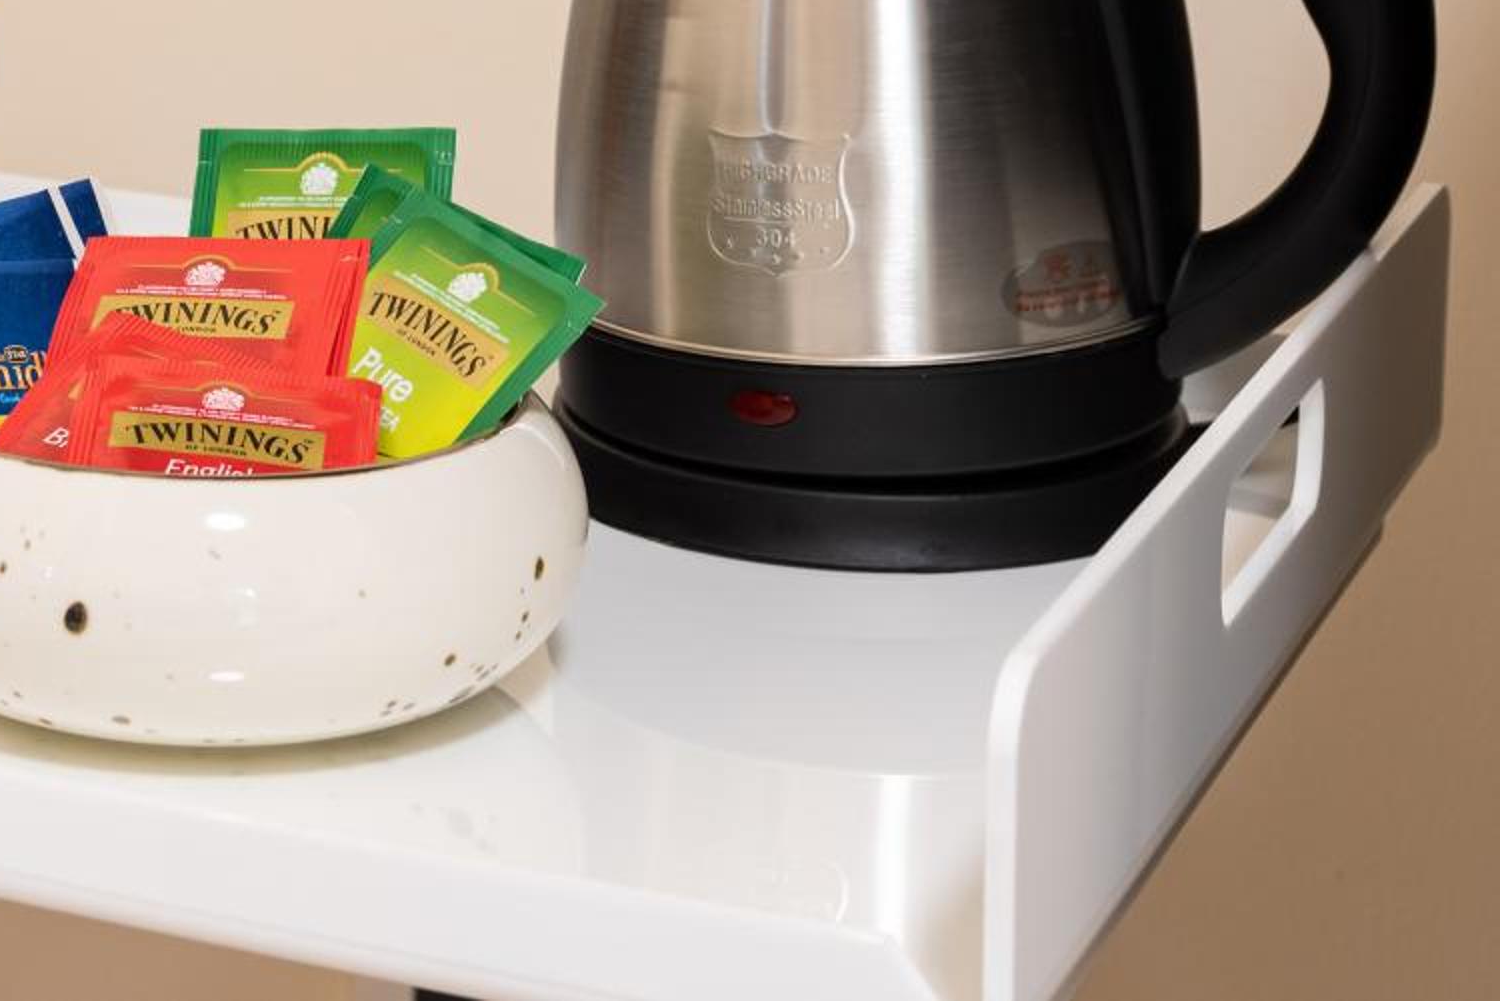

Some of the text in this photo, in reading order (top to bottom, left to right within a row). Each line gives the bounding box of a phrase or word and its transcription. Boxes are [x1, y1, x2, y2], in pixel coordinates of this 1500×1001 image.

[114, 301, 277, 335] WININGS
[368, 291, 487, 378] TWININGS
[351, 346, 414, 403] Pure
[380, 406, 401, 433] EA
[126, 422, 309, 464] TWININGS
